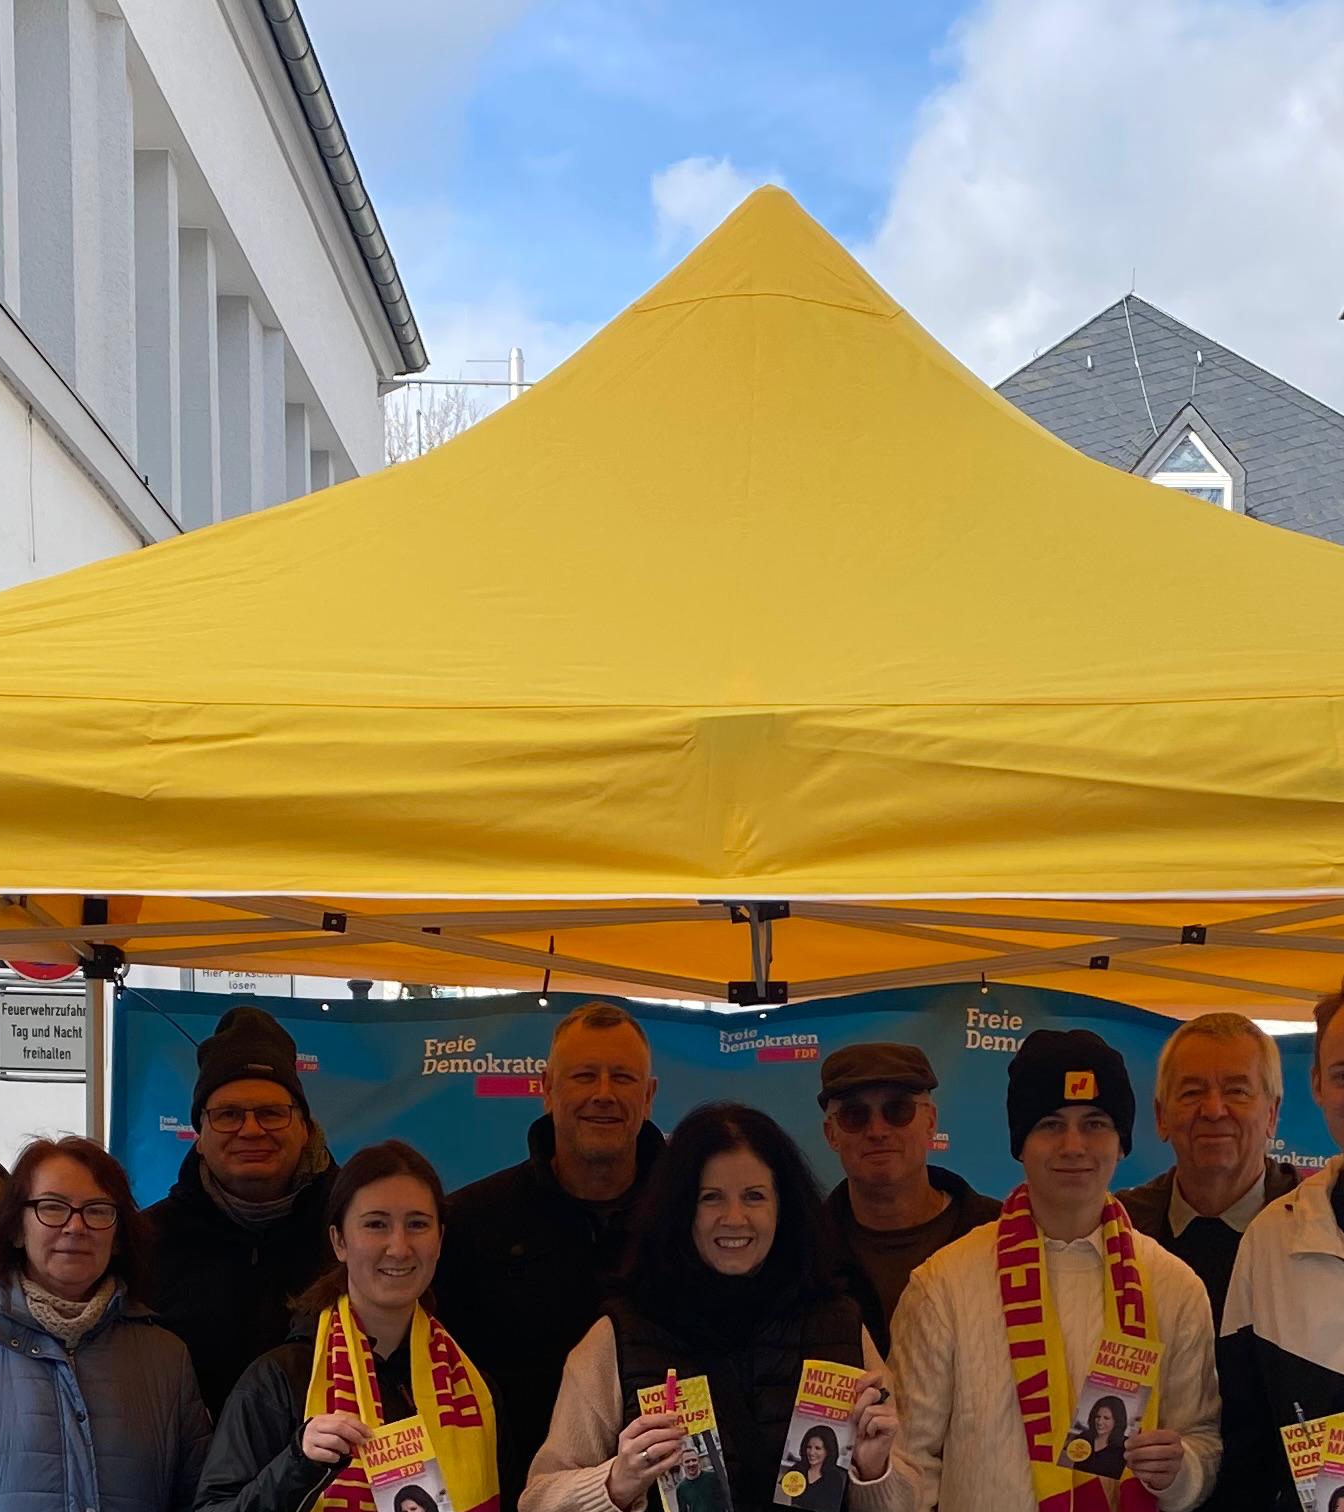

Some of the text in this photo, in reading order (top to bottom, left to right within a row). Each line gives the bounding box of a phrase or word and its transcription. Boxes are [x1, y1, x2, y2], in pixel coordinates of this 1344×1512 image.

[229, 981, 256, 989] lösen
[2, 1002, 86, 1017] Feuerwehrzufahr
[966, 1007, 1023, 1031] Freie
[11, 1024, 83, 1040] Tag und Nacht
[720, 1028, 758, 1043] Freie
[423, 1035, 476, 1058] Freie
[720, 1033, 818, 1053] Demokraten
[23, 1047, 72, 1061] freihalten
[794, 1049, 817, 1060] FDP
[422, 1053, 548, 1076] Demokrate
[1100, 1339, 1158, 1364] MUT ZUM
[1096, 1352, 1150, 1376] MACHEN
[807, 1368, 836, 1384] MUT
[804, 1382, 859, 1404] MACHEN
[1116, 1379, 1139, 1392] FDP
[826, 1408, 848, 1419] FDP
[1285, 1421, 1327, 1439] VOLLE
[364, 1426, 424, 1455] MUT ZUM
[1288, 1436, 1324, 1453] KRAF
[367, 1440, 424, 1468] MACHEN
[1293, 1452, 1320, 1467] VOR
[400, 1463, 424, 1478] FDP
